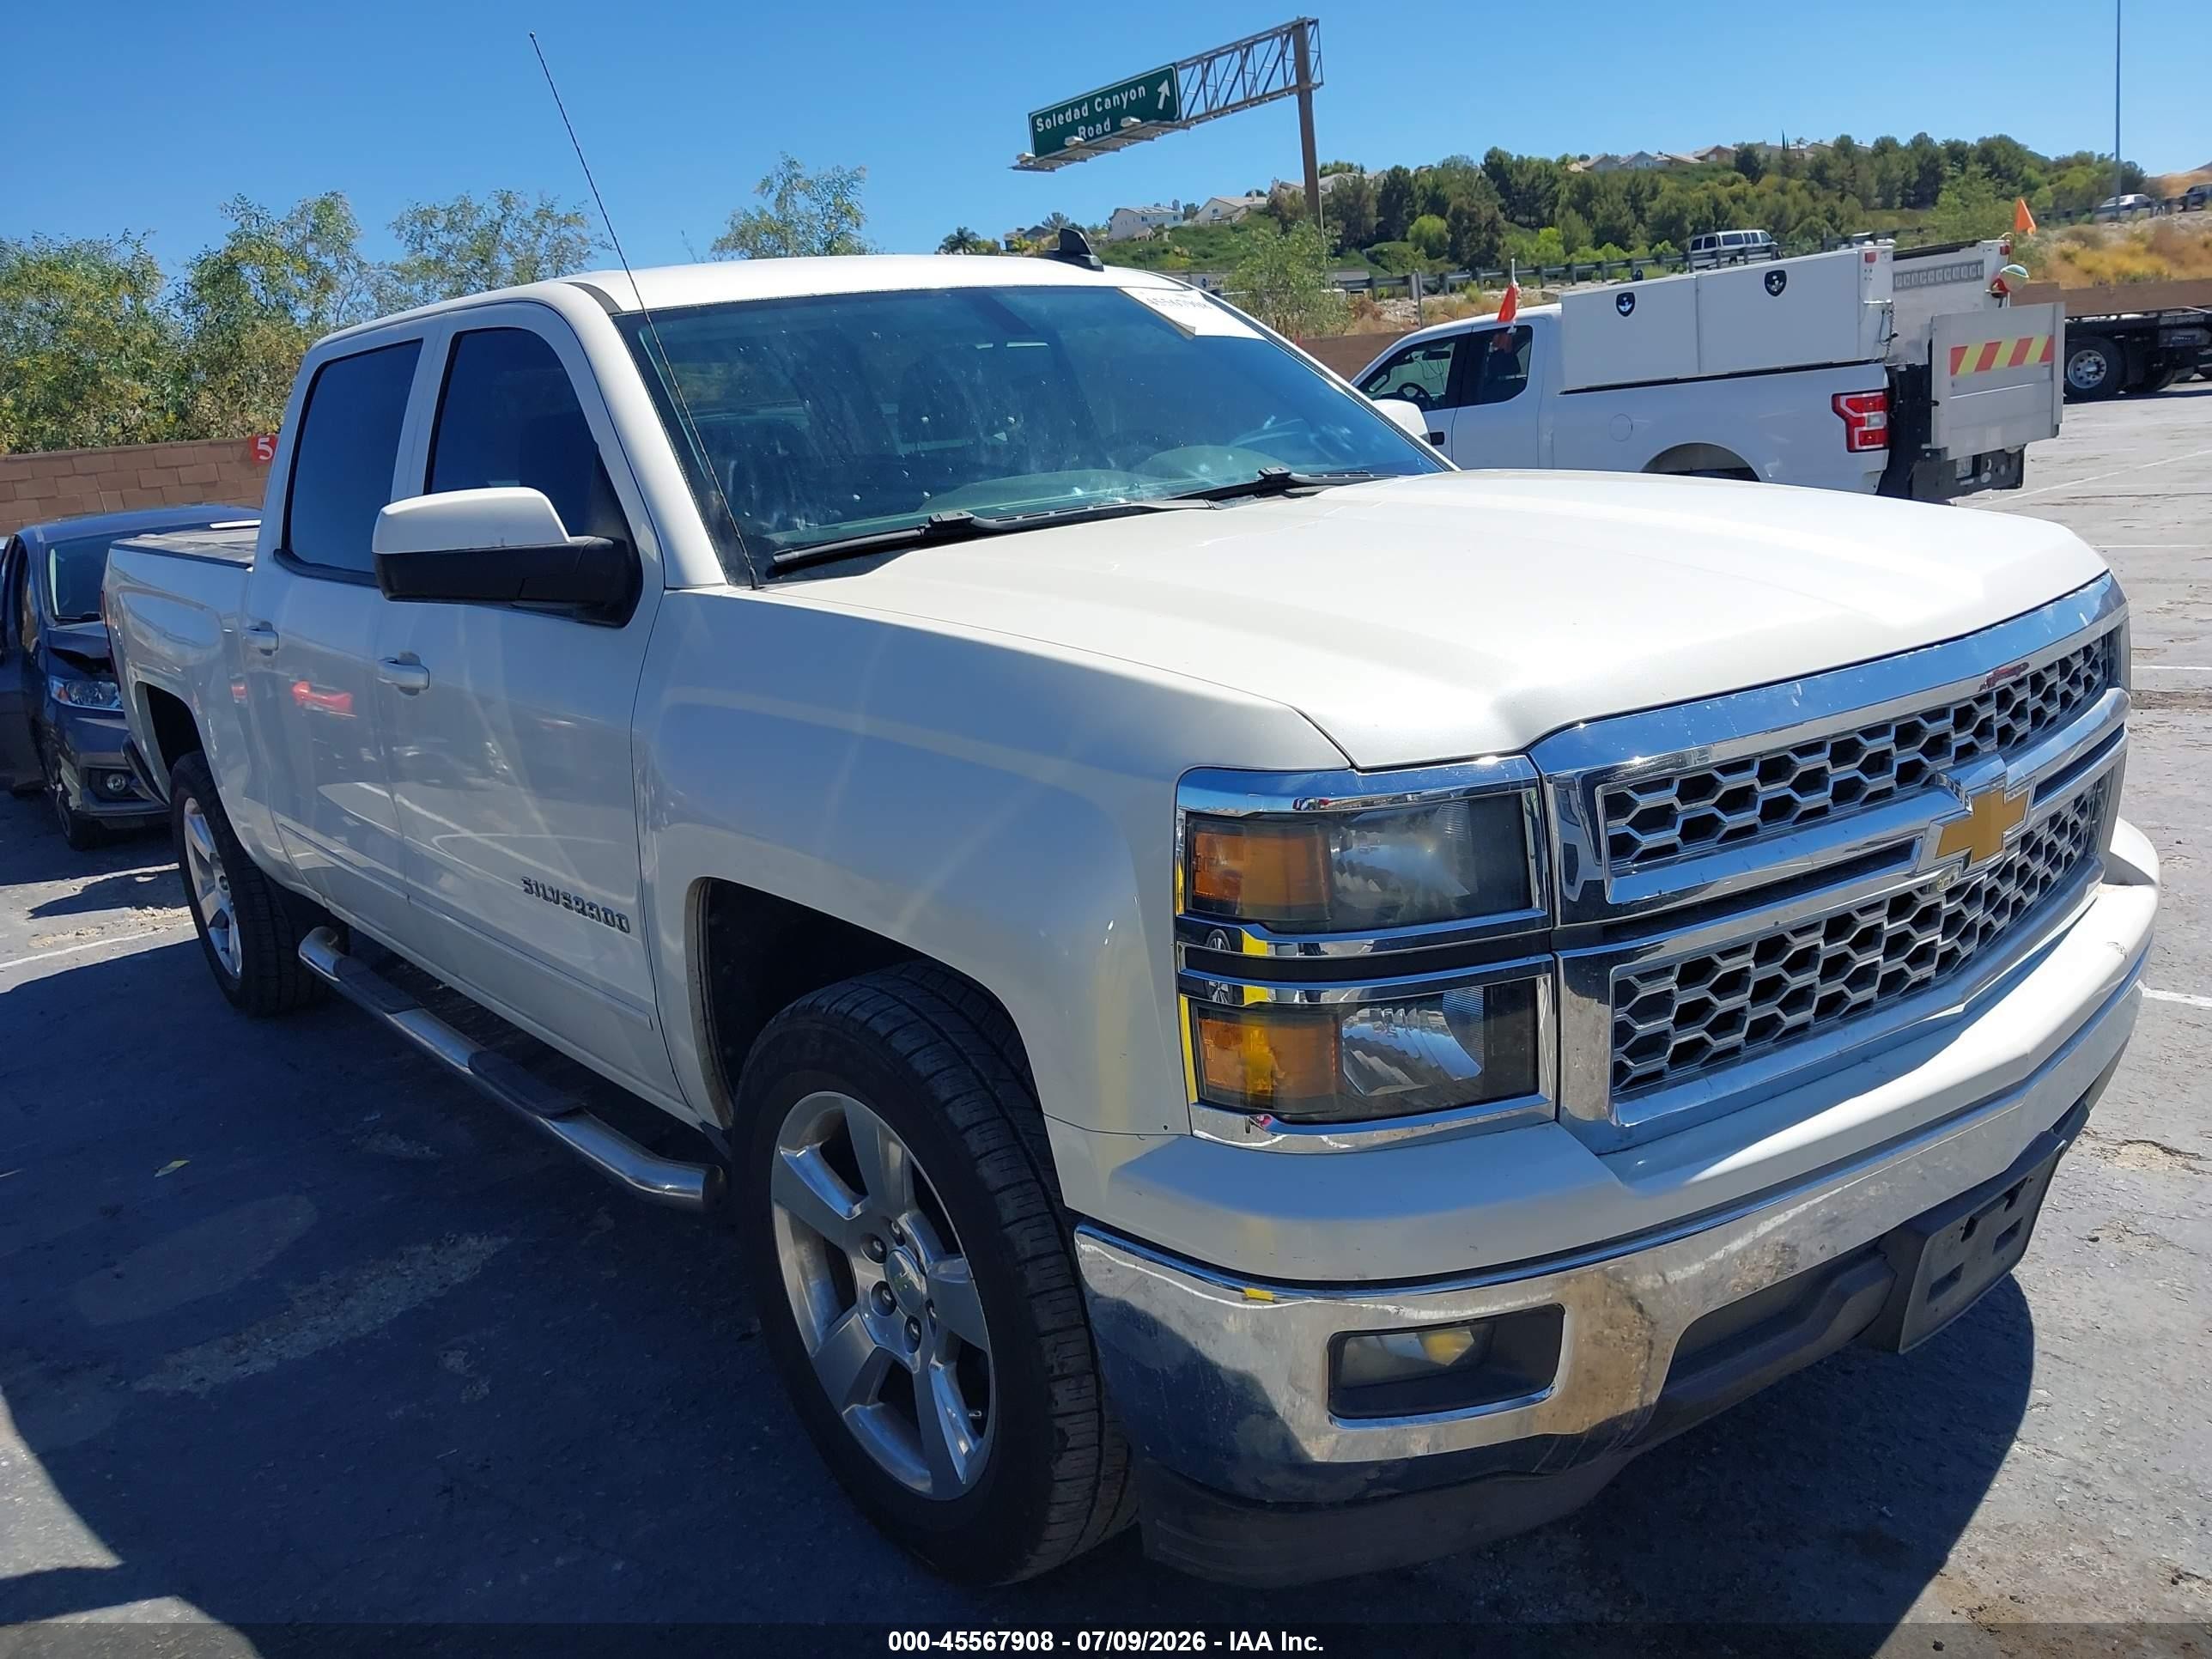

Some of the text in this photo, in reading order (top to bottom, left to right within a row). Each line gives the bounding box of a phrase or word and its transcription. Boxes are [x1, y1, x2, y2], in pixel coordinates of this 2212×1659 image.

[1036, 85, 1146, 132] Soledad Canyon
[1078, 117, 1111, 141] Road
[258, 437, 273, 460] 5
[520, 876, 631, 934] SILVERADO
